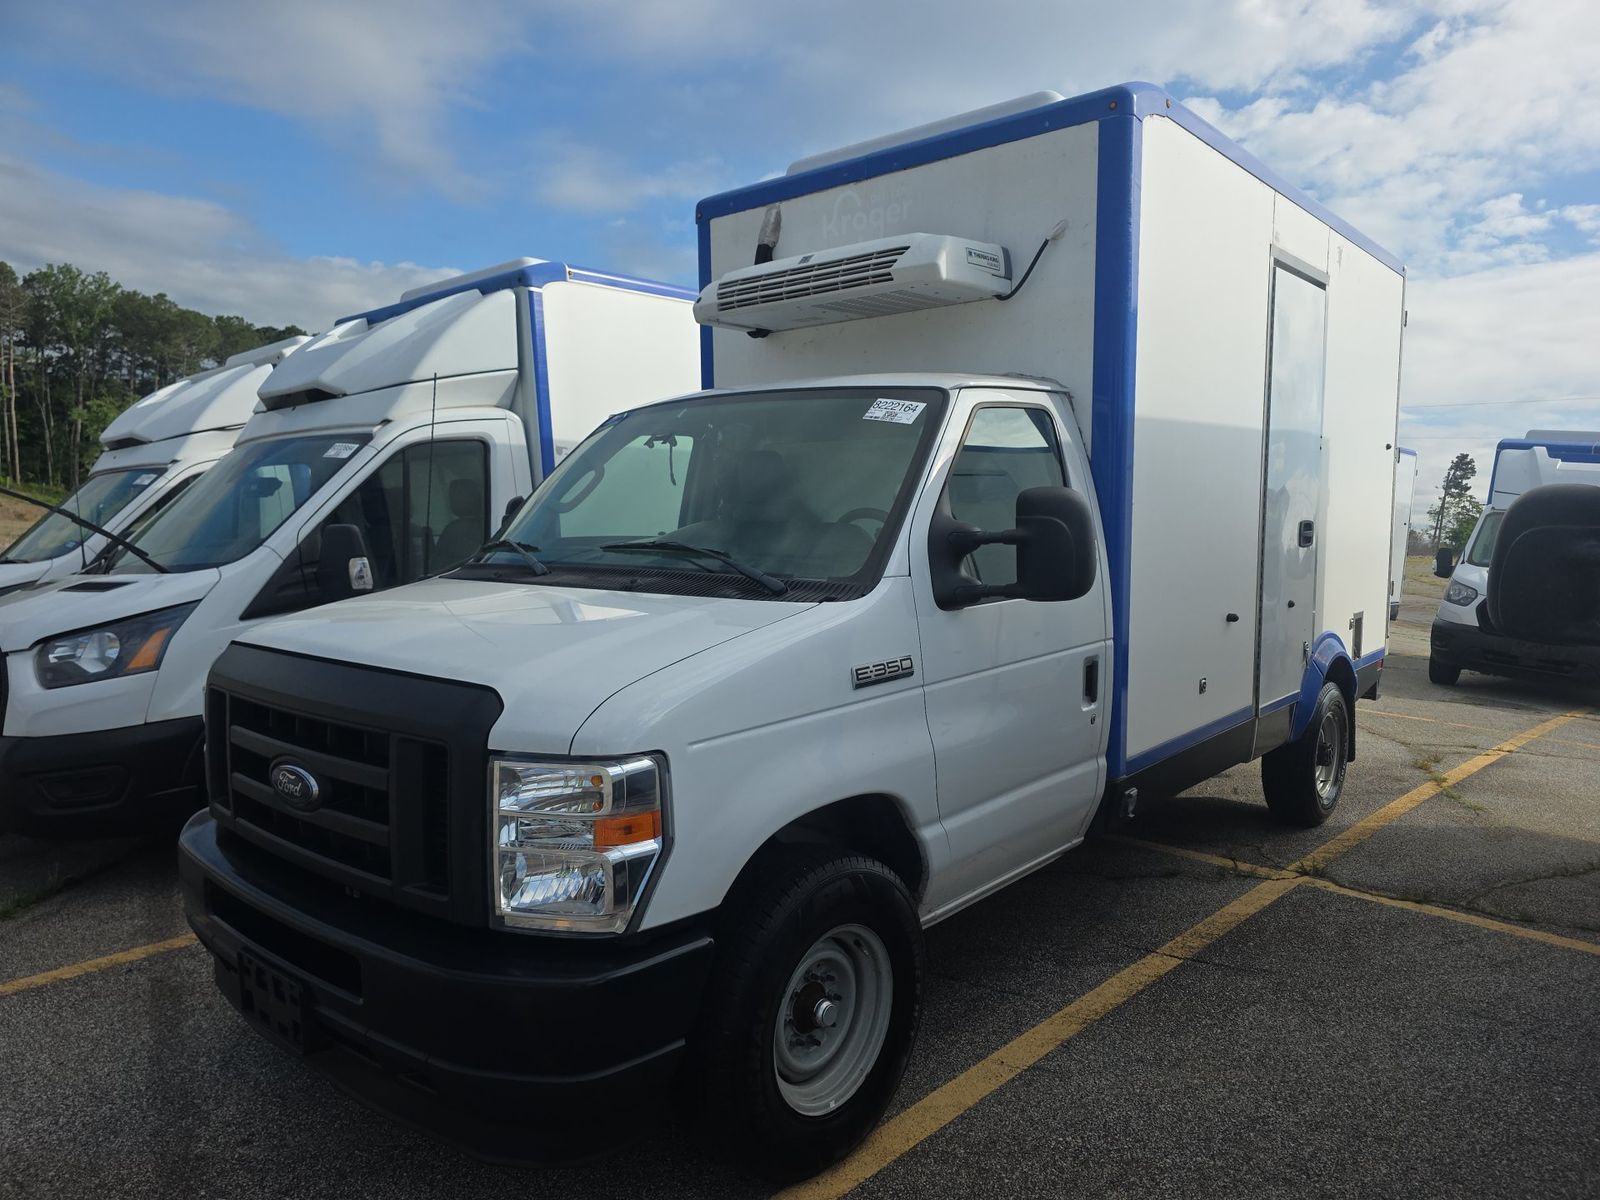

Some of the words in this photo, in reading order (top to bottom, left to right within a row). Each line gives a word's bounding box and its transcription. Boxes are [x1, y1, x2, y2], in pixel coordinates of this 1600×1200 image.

[873, 400, 918, 412] 8222164
[855, 657, 913, 681] E-350
[278, 771, 302, 797] Ford
